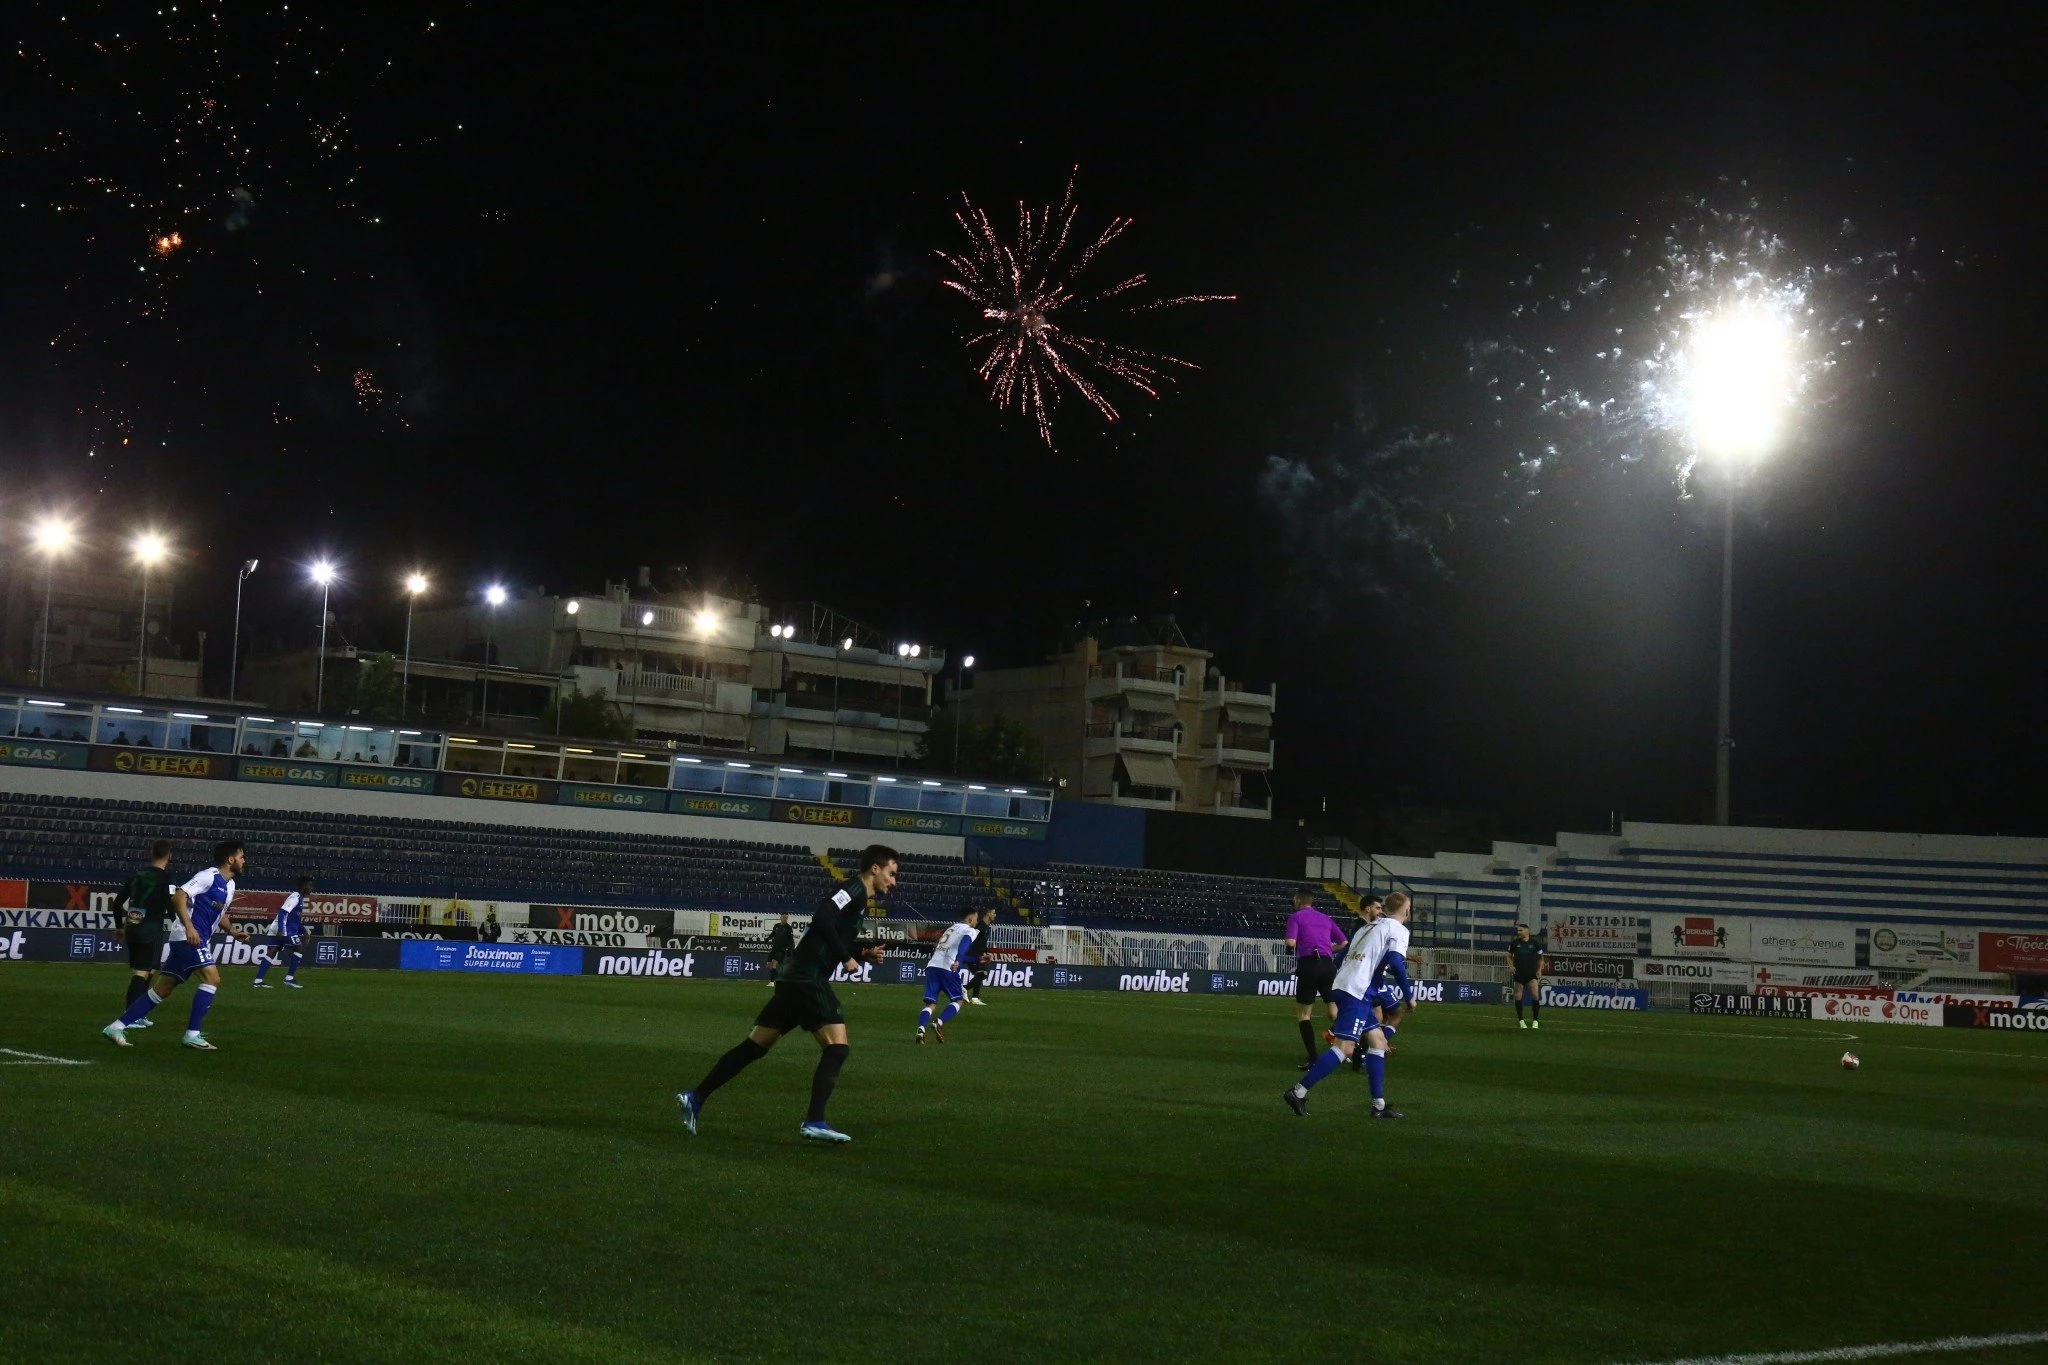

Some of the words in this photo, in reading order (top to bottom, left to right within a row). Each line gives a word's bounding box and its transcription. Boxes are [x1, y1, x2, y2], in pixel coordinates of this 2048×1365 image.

[14, 748, 56, 761] GAS
[141, 754, 206, 774] ETEKA
[244, 767, 284, 778] ETEKA
[288, 768, 325, 781] GAS
[346, 774, 384, 785] ETEKA
[388, 776, 423, 788] GAS
[482, 781, 536, 799] ETEKA
[576, 791, 610, 802] ETEKA
[613, 793, 644, 805] GAS
[687, 800, 718, 811] ETEKA
[721, 802, 750, 813] GAS
[805, 808, 850, 823] ETEKA
[916, 818, 943, 829] GAS
[1003, 825, 1029, 835] GAS
[65, 884, 130, 911] Xm
[722, 915, 763, 931] Repair
[1569, 915, 1636, 927] ΡΕΚΤΙΦΙΕ
[877, 926, 905, 940] Riva
[1563, 928, 1619, 938] SPECIAL
[99, 942, 122, 952] 21+
[1762, 936, 1797, 947] athens
[340, 948, 361, 959] 21+
[466, 945, 524, 961] Stoiximan
[491, 960, 522, 969] LEAGUE
[598, 950, 694, 977] novibet
[744, 962, 761, 971] 21+
[1554, 958, 1625, 978] advertising
[917, 968, 926, 977] 21
[1069, 973, 1083, 982] 21+
[1666, 964, 1713, 978] miow
[1119, 969, 1190, 993] novibet
[1226, 979, 1239, 987] 21+
[1258, 974, 1299, 996] novi
[1471, 989, 1482, 997] 21+
[1539, 985, 1636, 1010] Stoiximan
[1842, 1001, 1870, 1017] One
[1900, 1004, 1929, 1021] One
